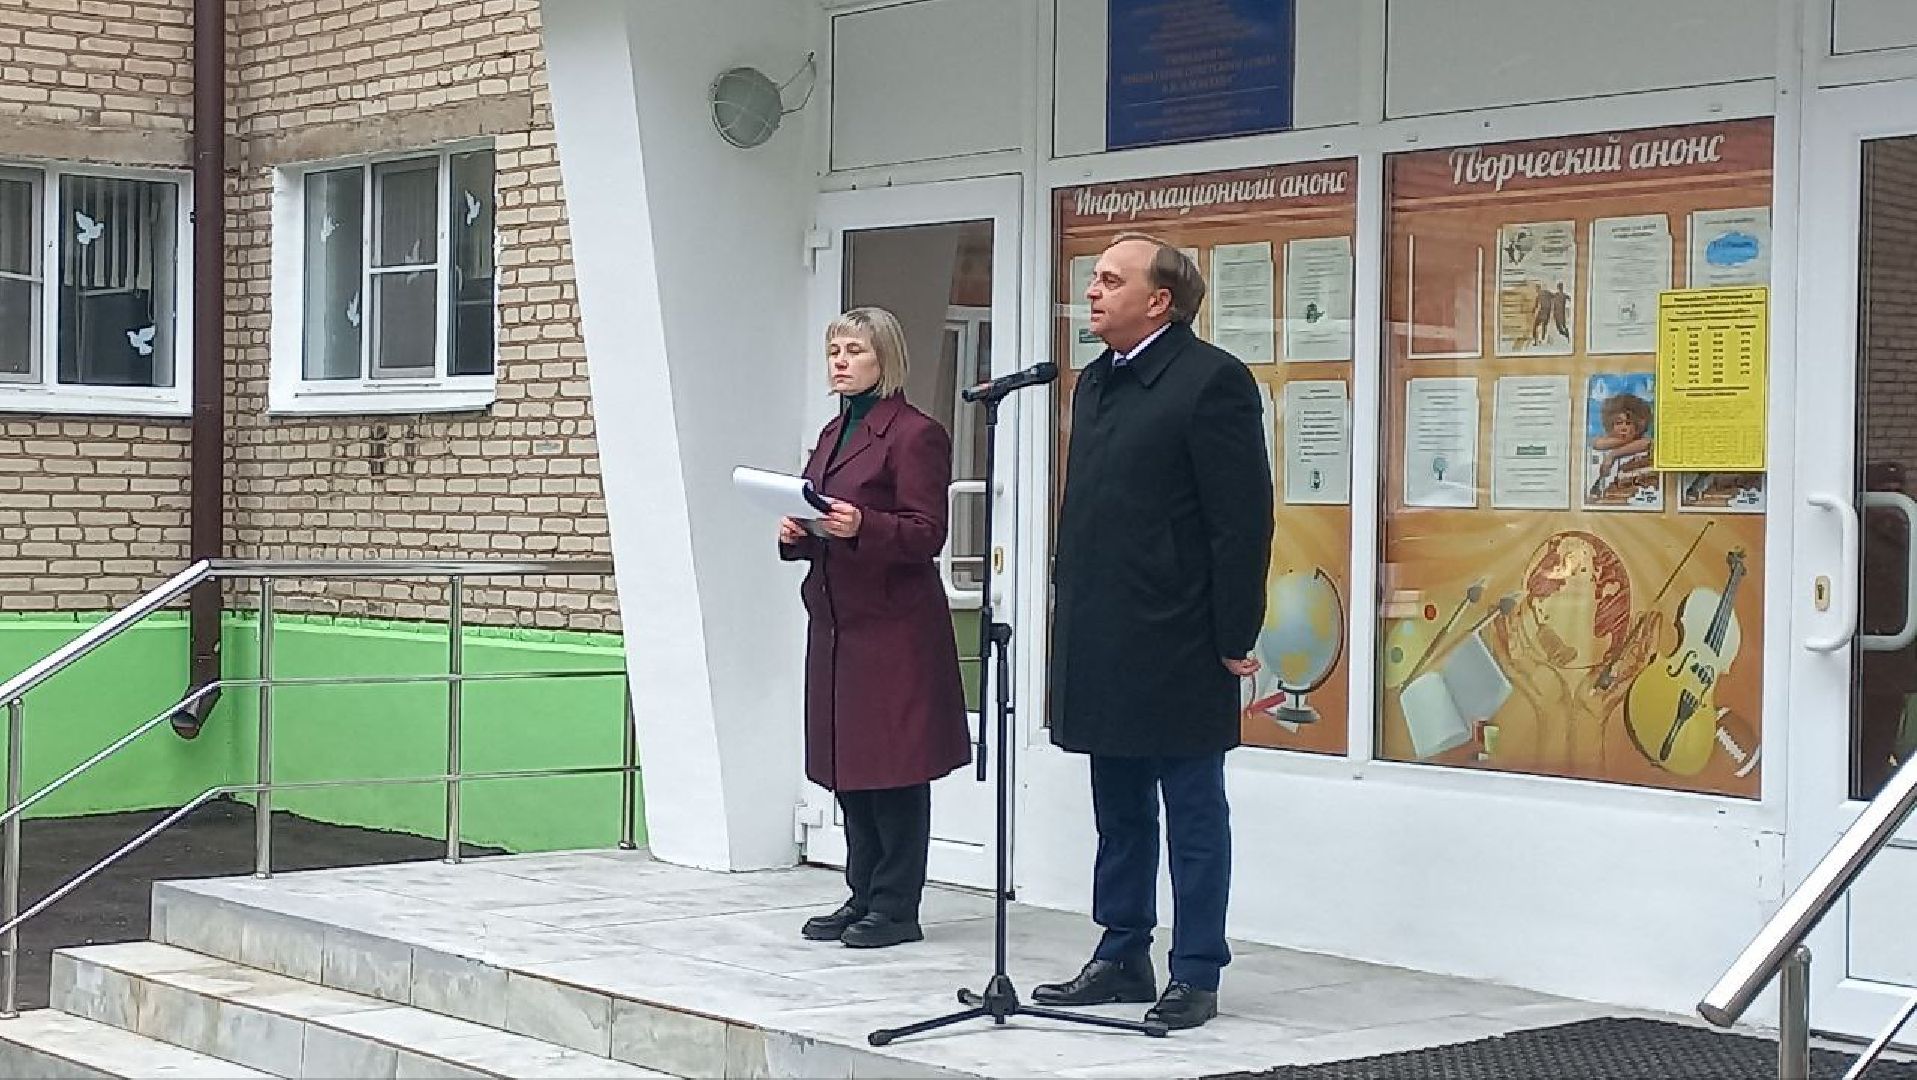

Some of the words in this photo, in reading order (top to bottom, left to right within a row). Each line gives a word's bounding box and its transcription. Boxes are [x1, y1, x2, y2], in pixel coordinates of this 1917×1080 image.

[1449, 136, 1622, 192] Творческий
[1630, 133, 1725, 170] анонс
[1074, 171, 1275, 220] Информационный
[1279, 171, 1348, 196] анонс
